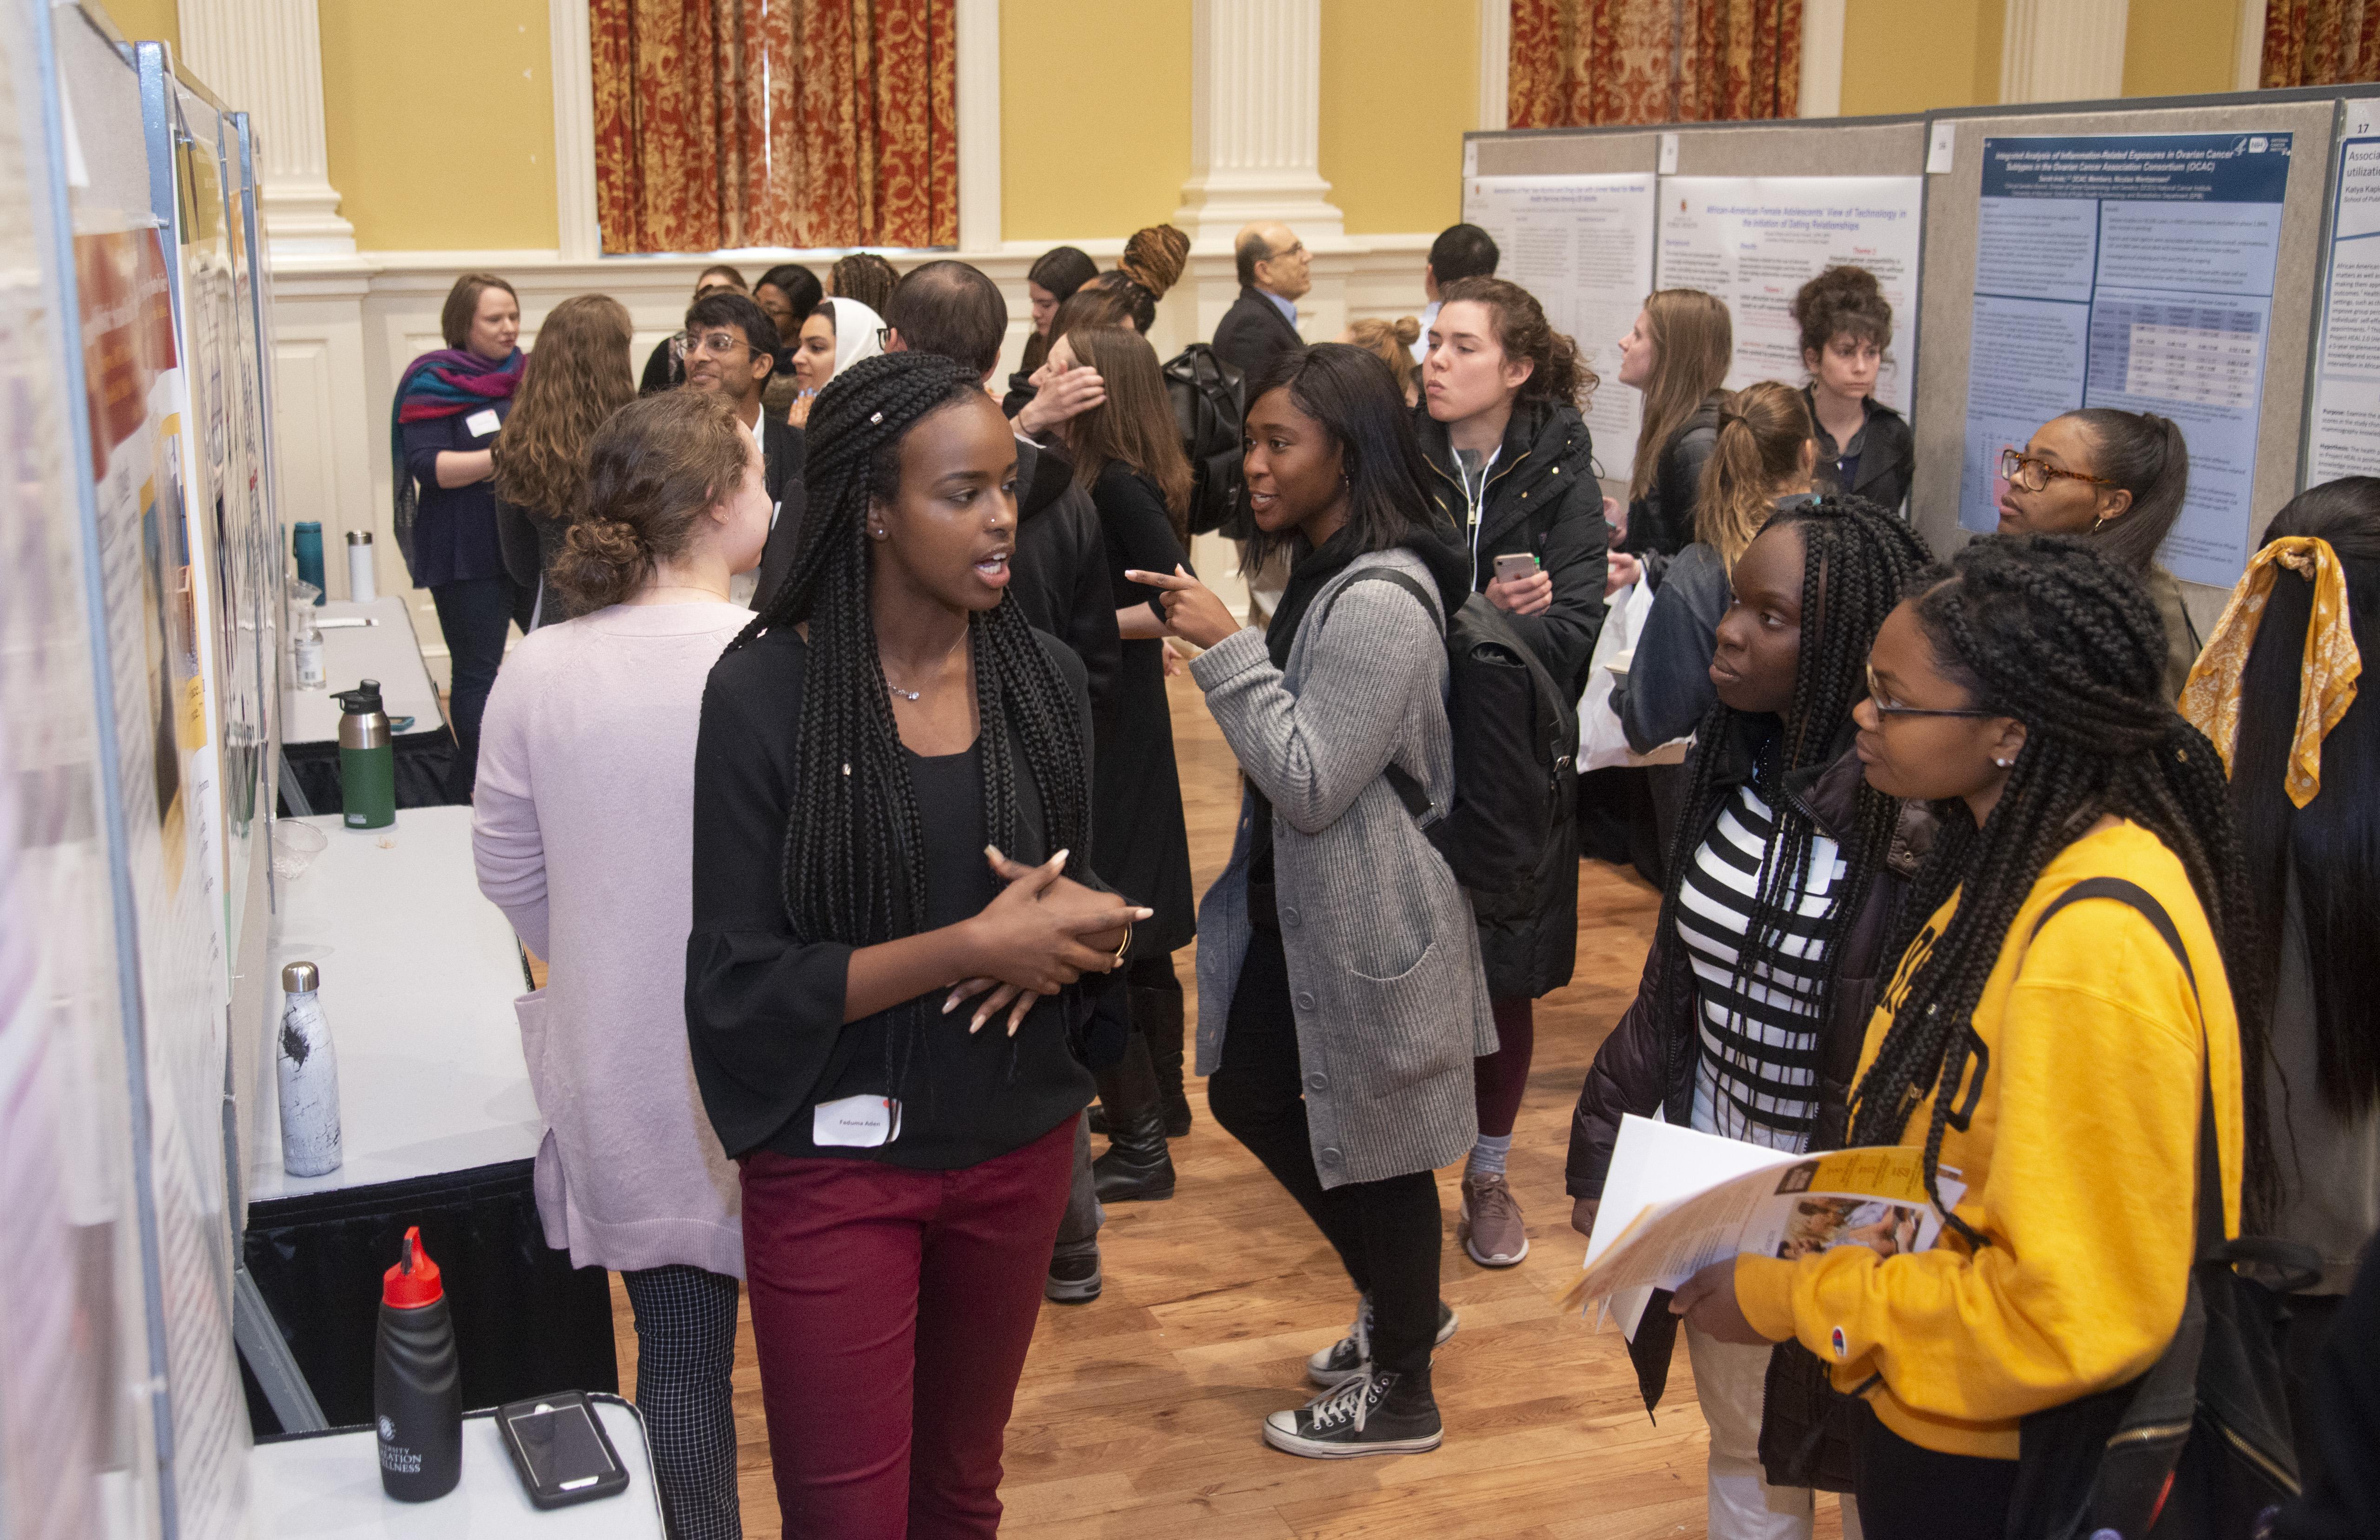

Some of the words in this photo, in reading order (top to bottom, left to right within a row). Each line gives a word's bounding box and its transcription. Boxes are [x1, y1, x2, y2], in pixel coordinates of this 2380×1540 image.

[2357, 124, 2369, 134] 17
[2175, 148, 2205, 159] Ovarian
[2206, 148, 2234, 159] Cancer
[2142, 161, 2185, 171] Consortium
[2185, 161, 2215, 173] (OCAC)
